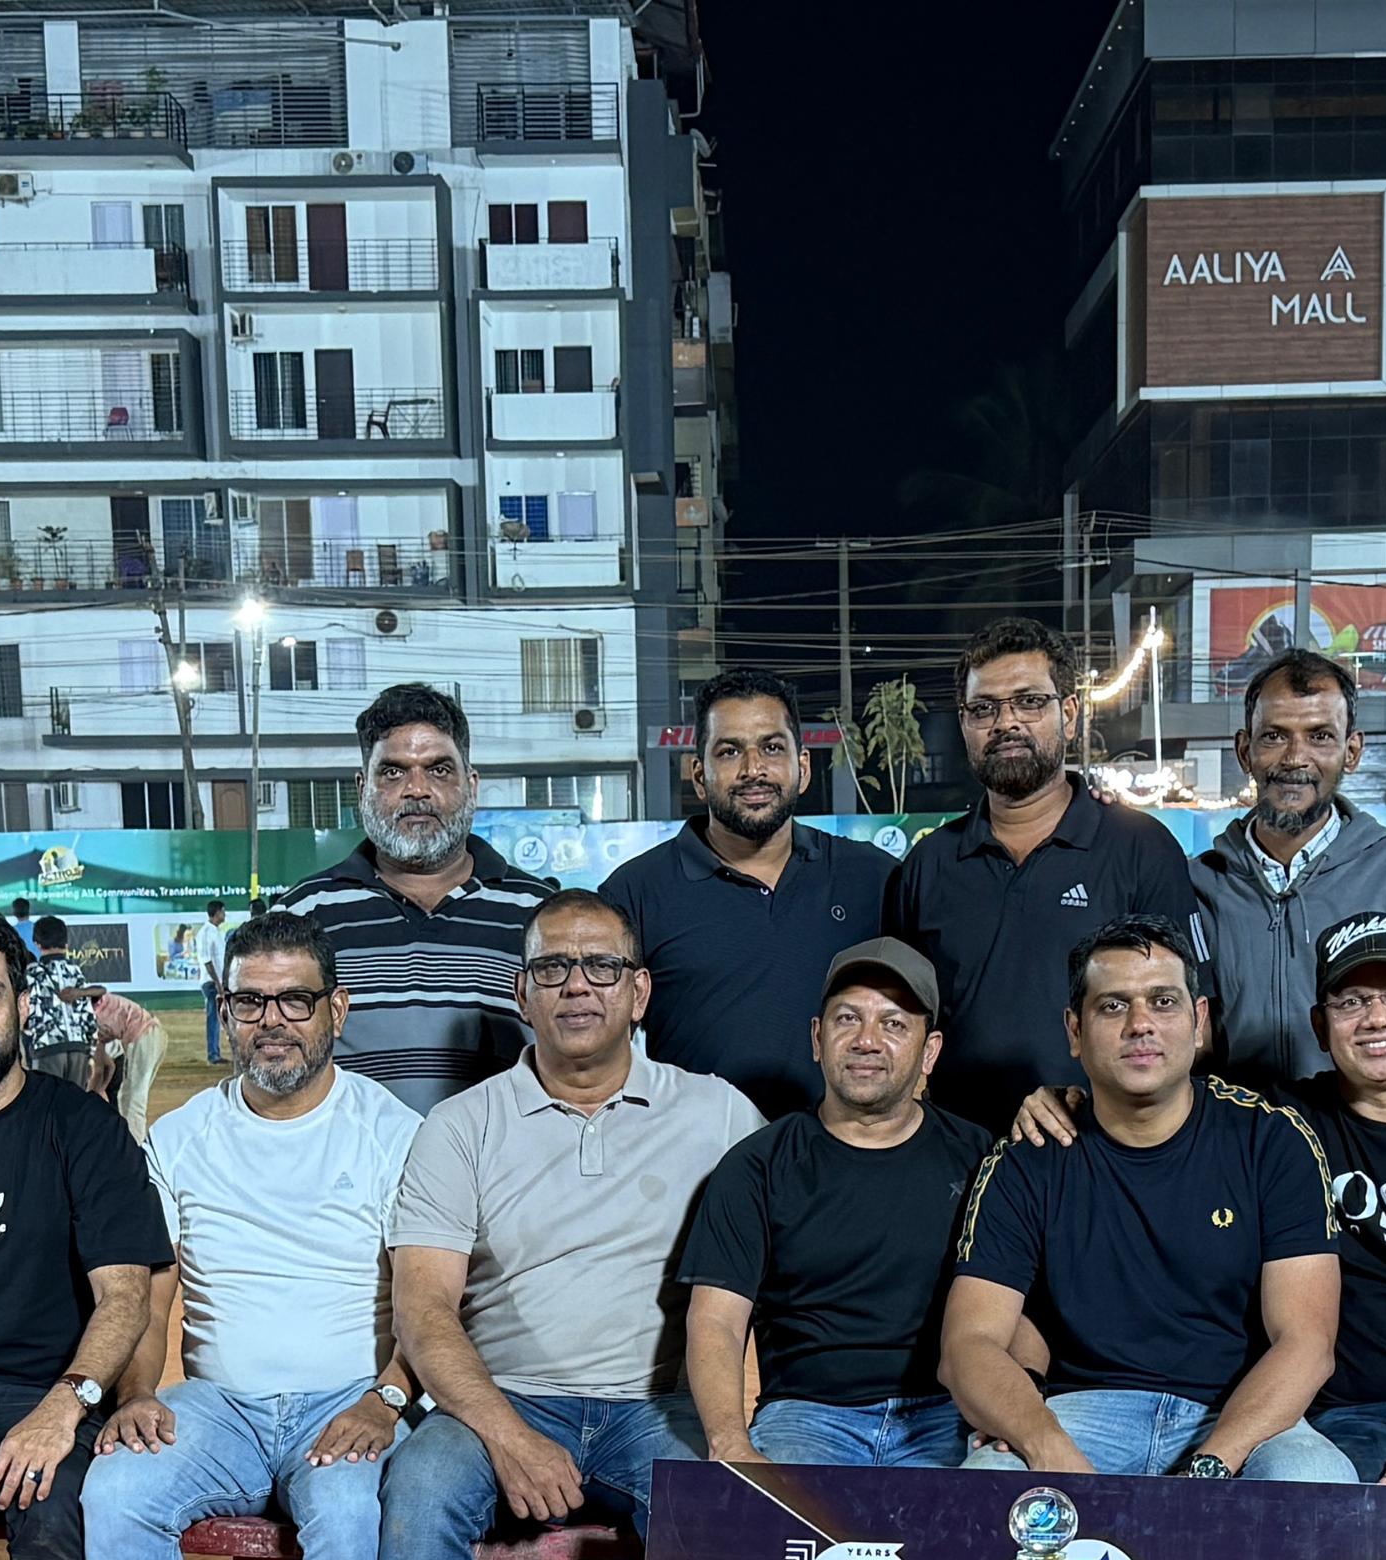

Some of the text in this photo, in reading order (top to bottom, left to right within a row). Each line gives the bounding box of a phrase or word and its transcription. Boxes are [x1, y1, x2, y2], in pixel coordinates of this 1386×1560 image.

[1163, 251, 1286, 285] AALIYA
[1271, 292, 1366, 326] MALL
[82, 885, 95, 898] All
[97, 884, 158, 899] Communities,
[160, 884, 220, 898] Transforming
[222, 883, 246, 897] Lives
[847, 1547, 891, 1558] YEARS
